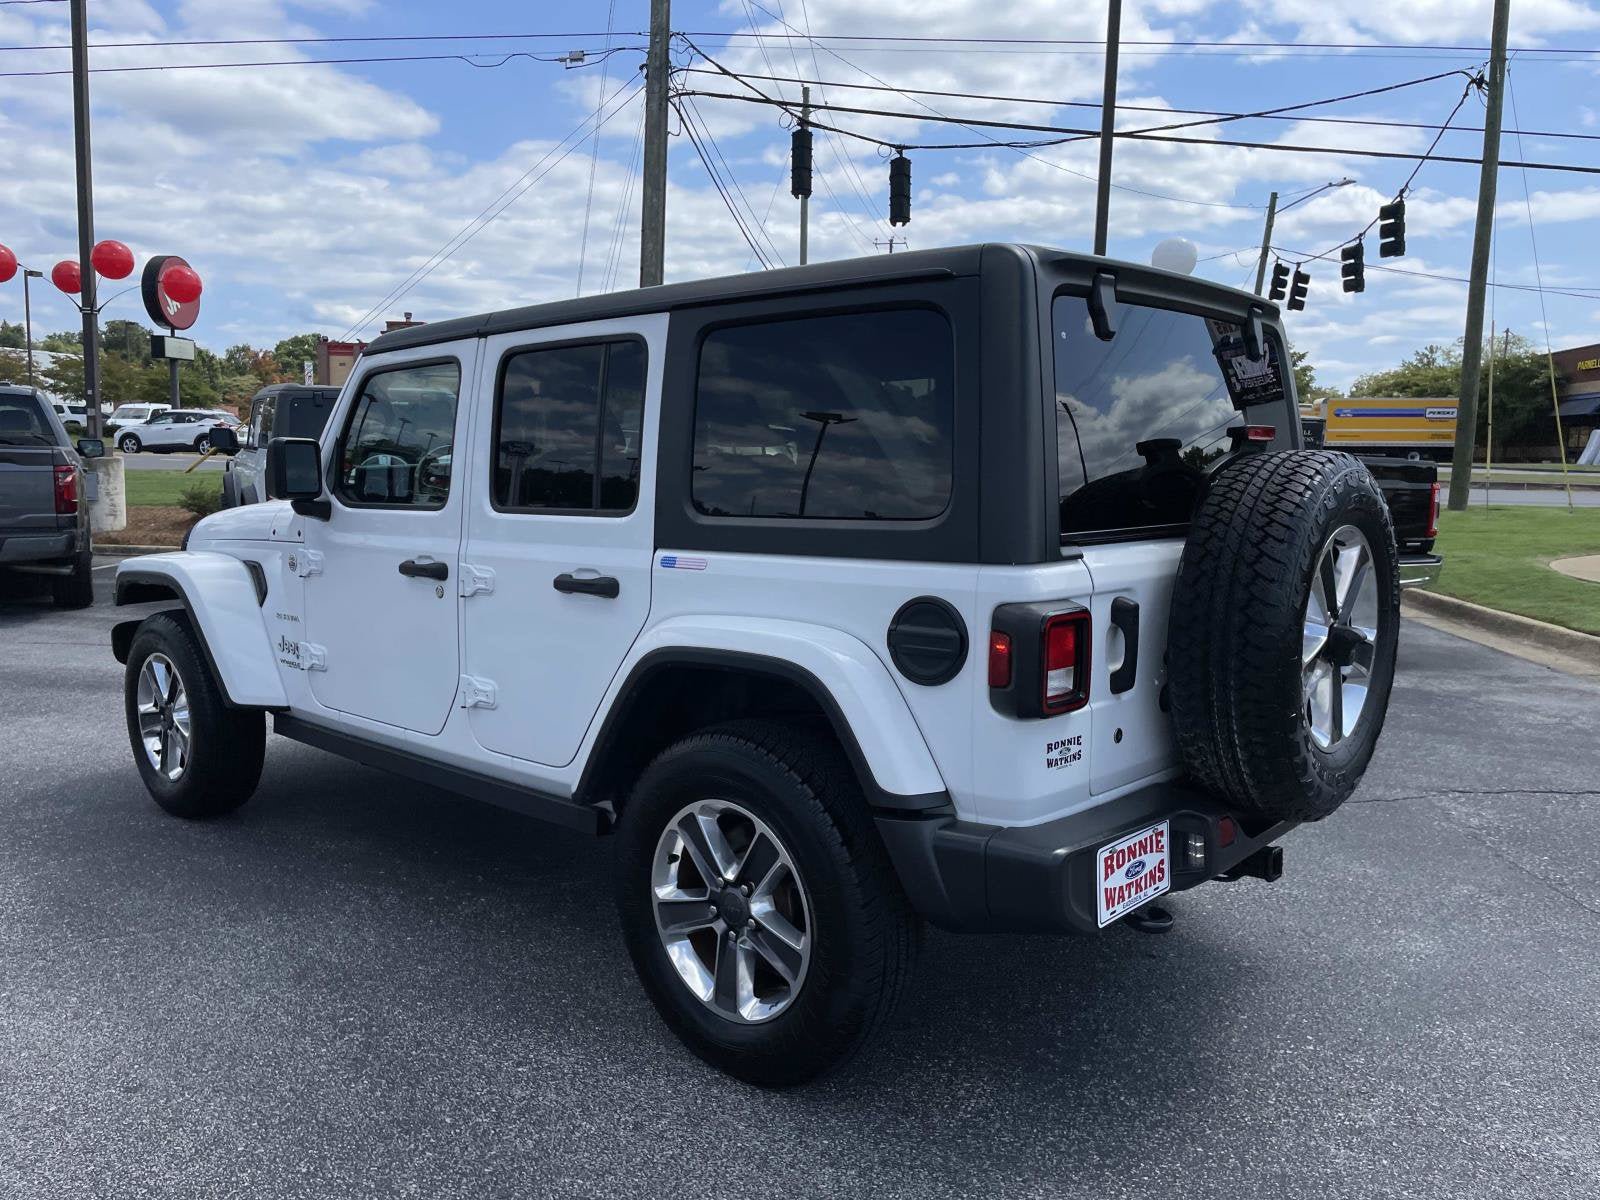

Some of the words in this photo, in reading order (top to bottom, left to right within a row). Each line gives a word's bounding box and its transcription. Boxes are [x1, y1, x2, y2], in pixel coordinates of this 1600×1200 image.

[278, 634, 299, 659] Jeep
[1046, 735, 1082, 754] RONNIE
[1046, 750, 1082, 769] WATKINS
[1104, 830, 1165, 882] RONNIE
[1127, 862, 1144, 877] Ford
[1104, 858, 1165, 911] WATKINS
